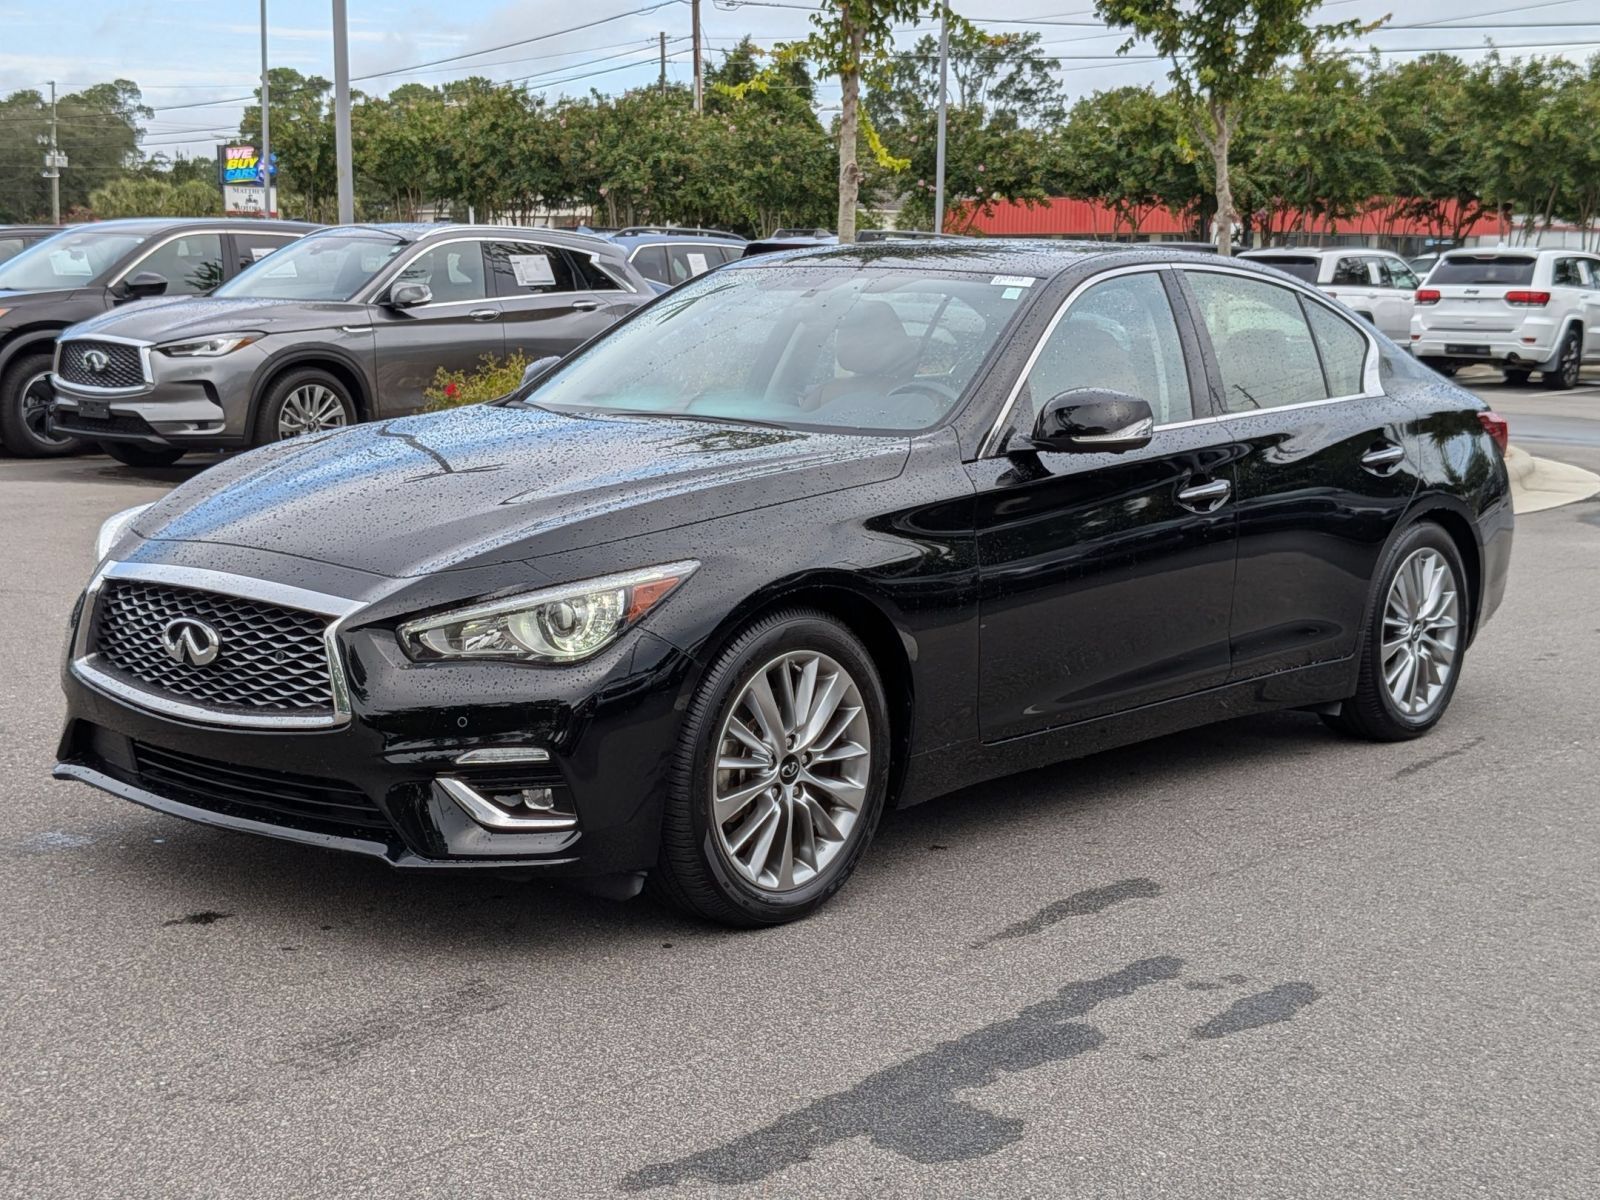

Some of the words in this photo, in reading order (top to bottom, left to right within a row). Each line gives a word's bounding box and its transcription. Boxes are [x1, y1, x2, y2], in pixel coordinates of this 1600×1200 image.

[226, 147, 255, 159] WE
[227, 158, 258, 169] BUY
[226, 169, 257, 180] CARS
